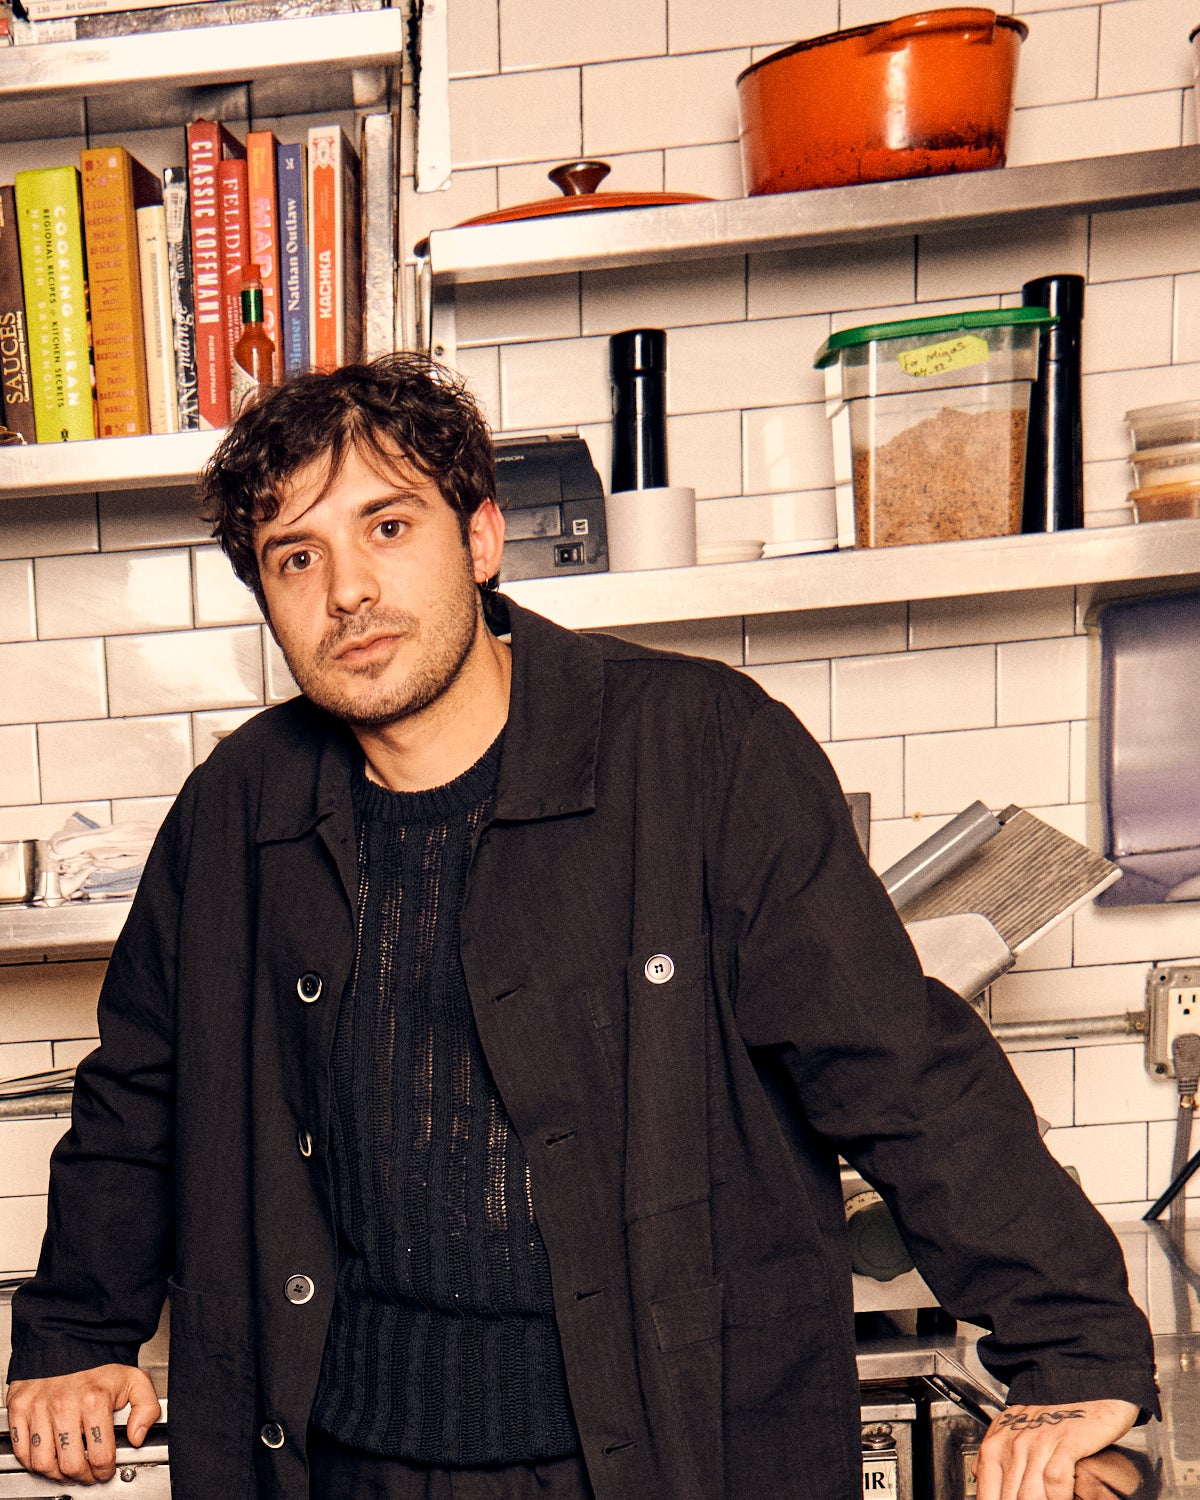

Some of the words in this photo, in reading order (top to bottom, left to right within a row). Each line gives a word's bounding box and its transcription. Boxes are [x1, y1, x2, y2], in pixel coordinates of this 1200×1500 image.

[191, 140, 216, 218] CLASSIC
[43, 208, 53, 263] REGIONAL
[223, 178, 242, 276] FELIDIA
[285, 198, 300, 254] Outlaw
[47, 265, 57, 304] RECIPES
[195, 227, 220, 324] KOFFMANN
[286, 258, 301, 312] Nathan
[319, 250, 332, 319] KACHKA
[53, 205, 74, 318] COOKING
[64, 349, 79, 408] IRAN
[51, 321, 61, 365] KITCHEN
[54, 368, 64, 409] SECRETS
[864, 1471, 886, 1490] IR
